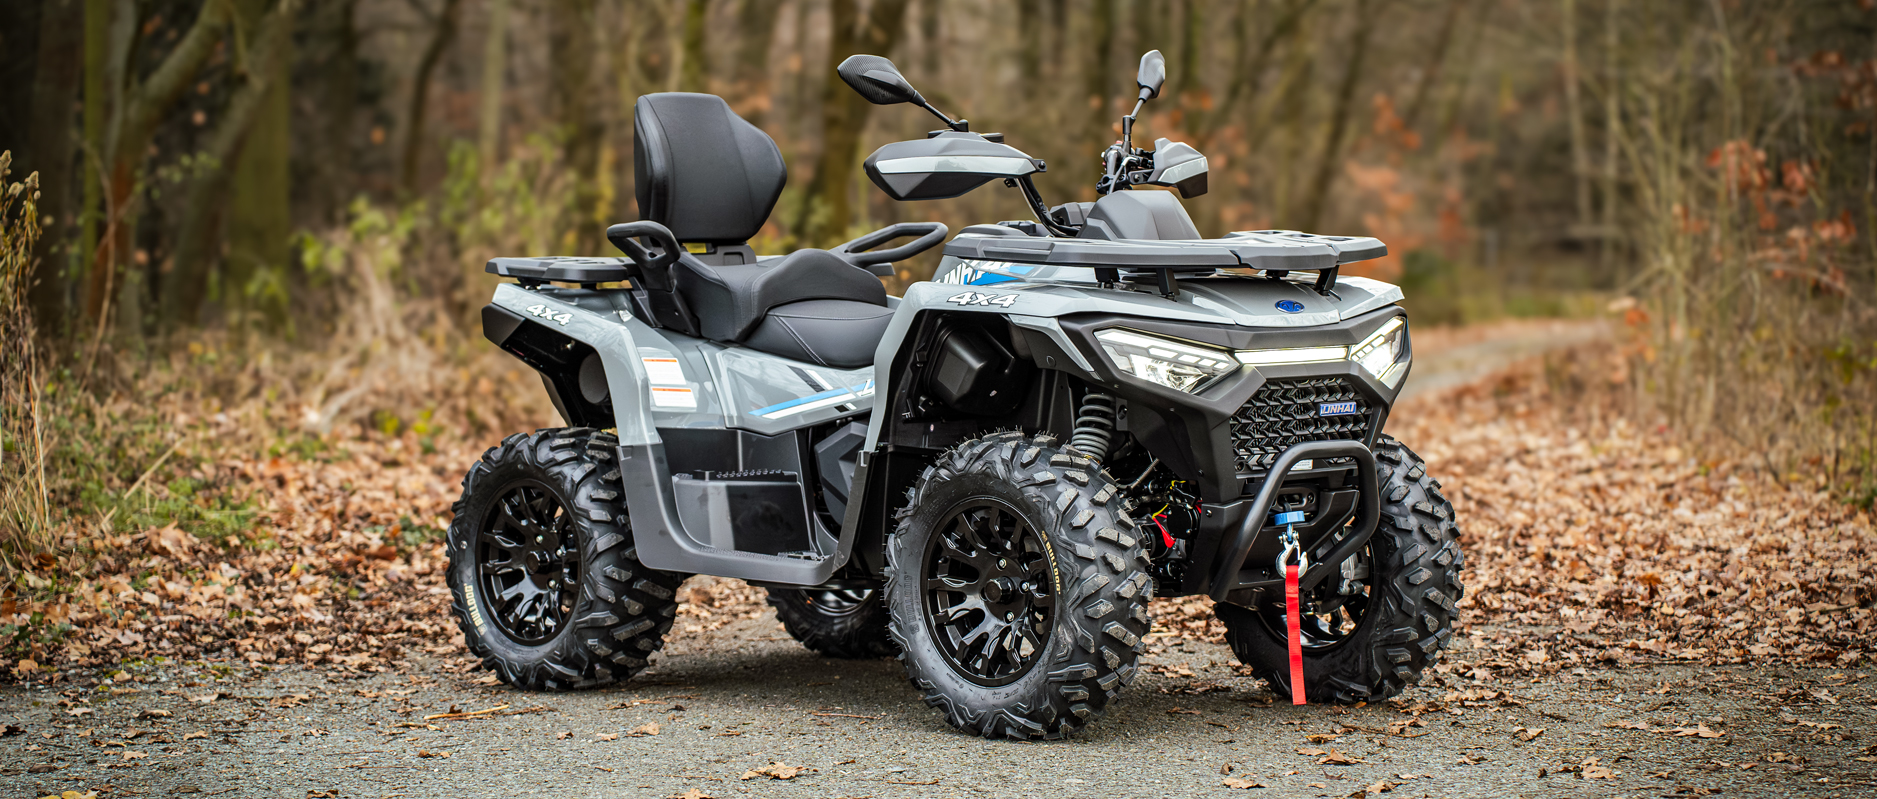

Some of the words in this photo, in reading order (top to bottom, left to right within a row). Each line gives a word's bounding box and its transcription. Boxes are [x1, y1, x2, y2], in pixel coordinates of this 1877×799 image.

[1322, 404, 1355, 414] LINHAI
[1045, 541, 1061, 592] BULLDOG
[464, 584, 484, 627] BULLDOG
